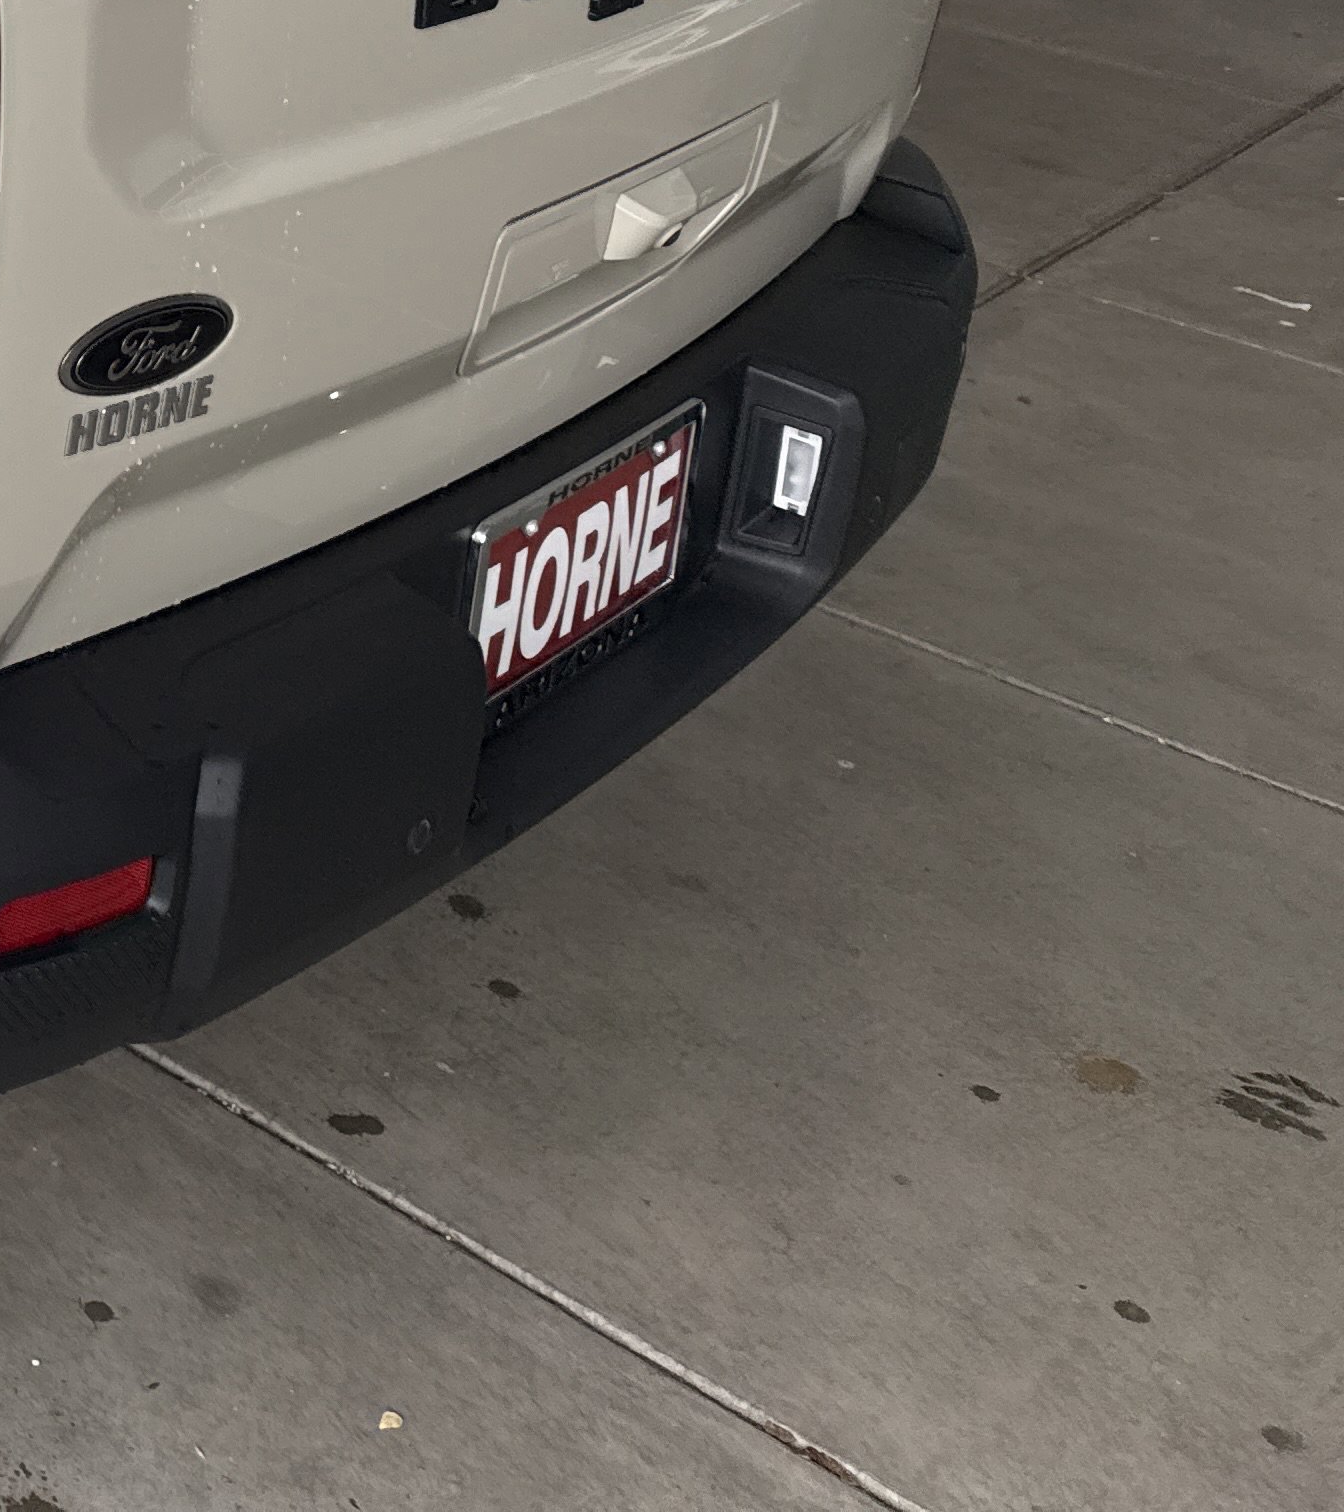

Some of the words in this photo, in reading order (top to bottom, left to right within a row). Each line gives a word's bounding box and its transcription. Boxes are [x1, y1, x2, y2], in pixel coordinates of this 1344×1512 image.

[107, 319, 201, 381] Ford
[64, 374, 214, 456] HORNE
[547, 432, 654, 507] HORNE
[478, 449, 682, 678] HORNE
